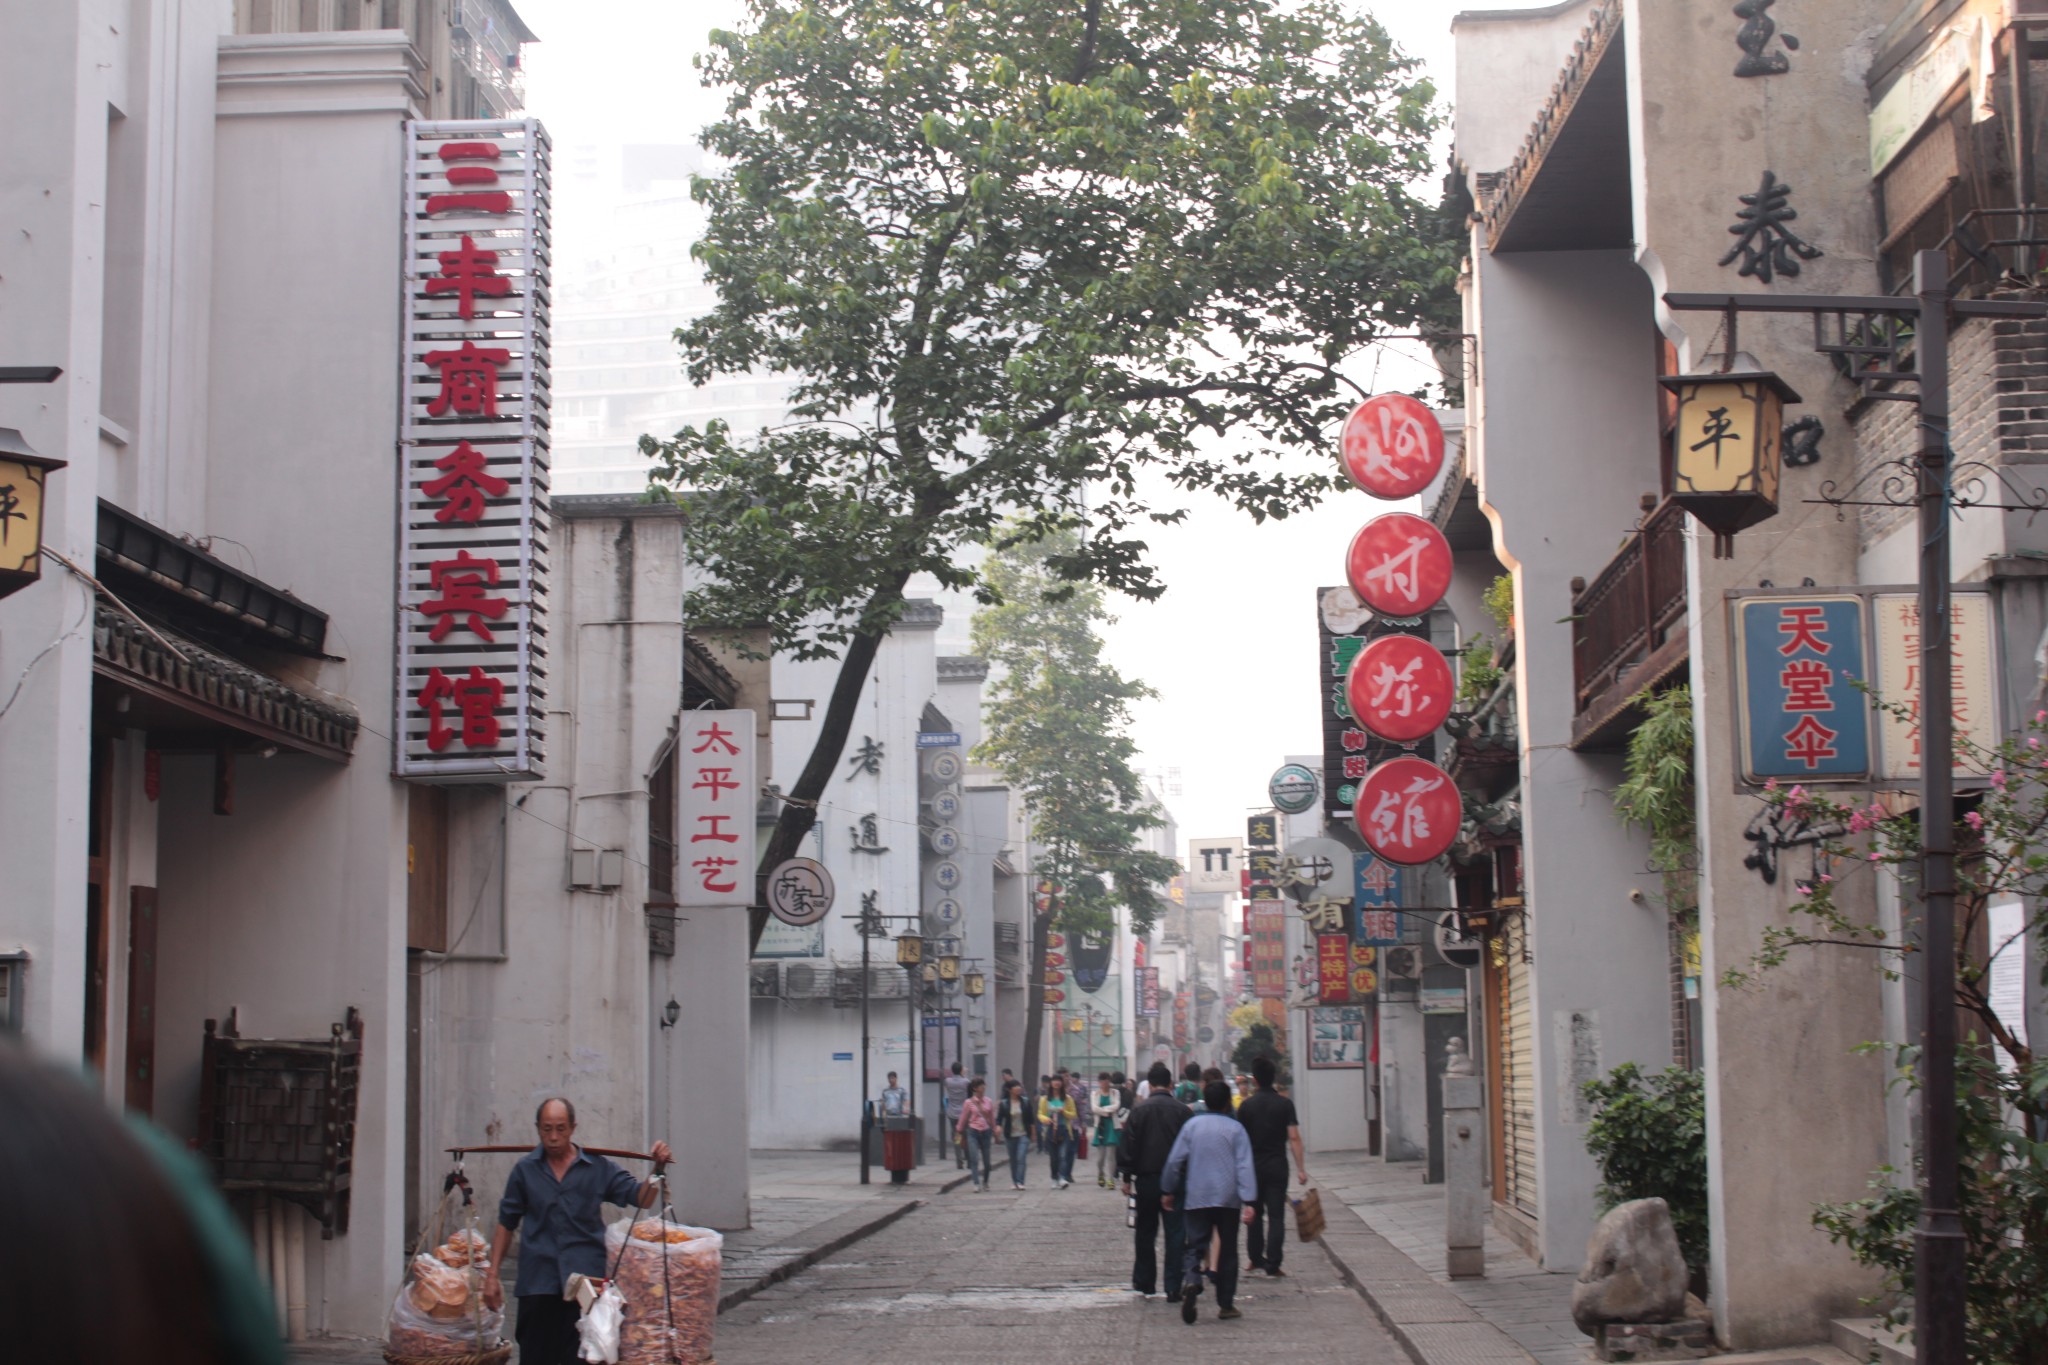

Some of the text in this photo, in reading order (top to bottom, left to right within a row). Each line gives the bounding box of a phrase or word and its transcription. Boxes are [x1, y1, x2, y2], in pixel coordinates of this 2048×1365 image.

[416, 141, 514, 752] 三丰商务宾馆
[1690, 406, 1740, 469] 平
[1777, 605, 1839, 770] 天堂伞
[691, 721, 741, 893] 太平工艺
[1273, 784, 1313, 794] Heineken
[1199, 847, 1232, 871] TT
[1360, 857, 1398, 940] 伞铺
[1321, 939, 1348, 998] 土特产
